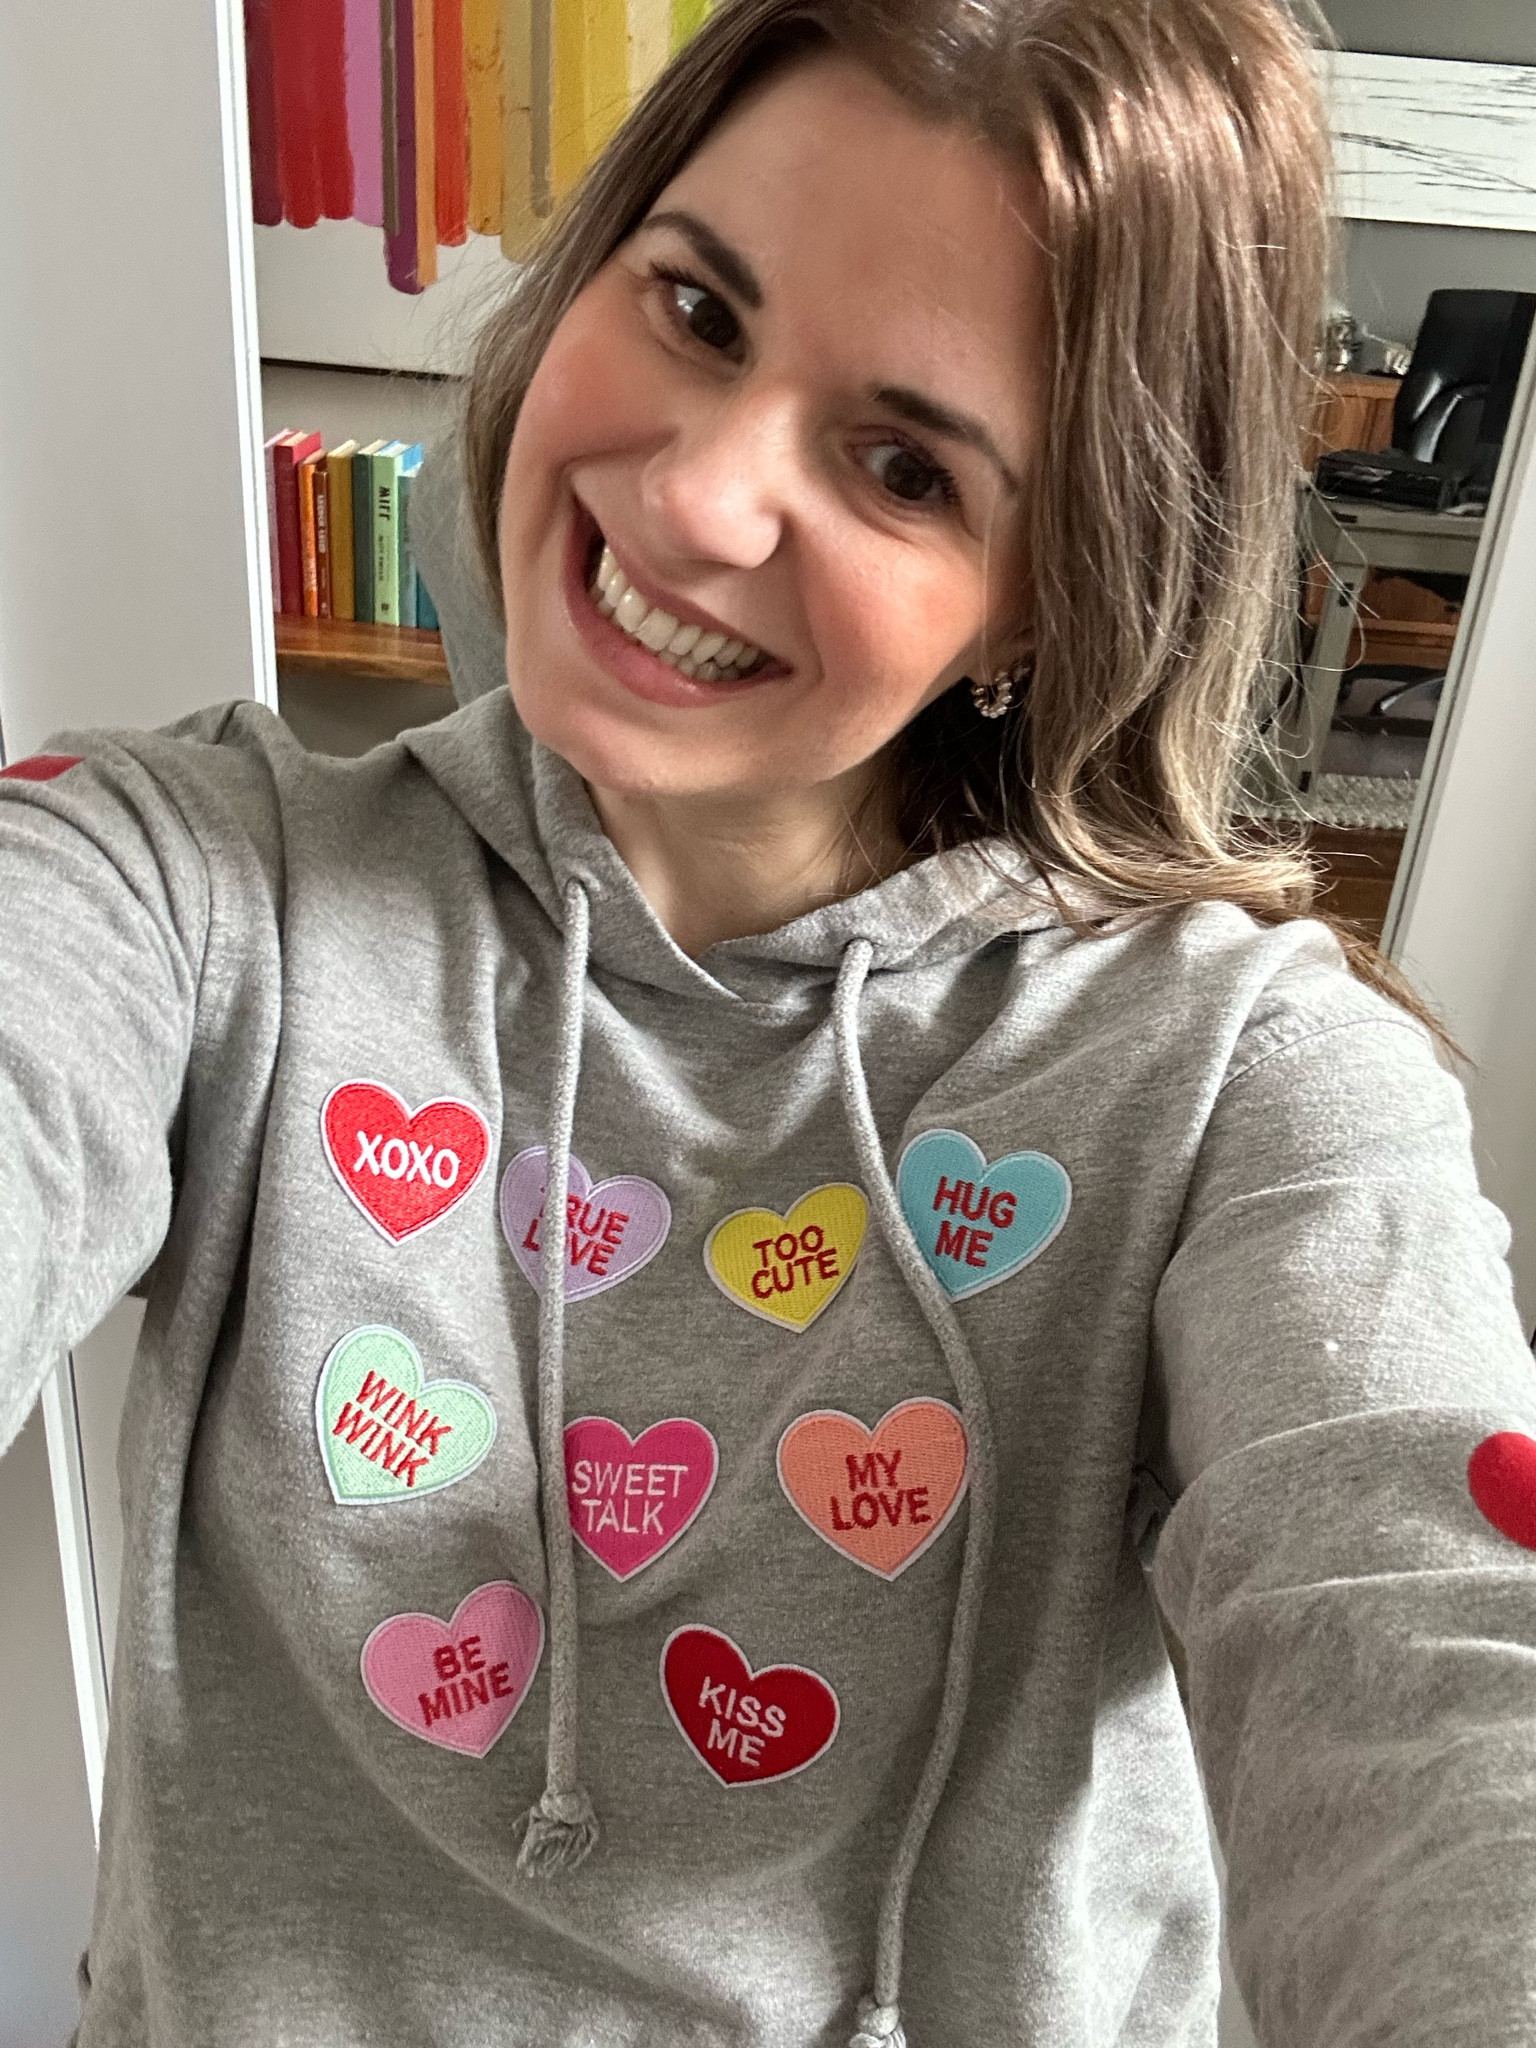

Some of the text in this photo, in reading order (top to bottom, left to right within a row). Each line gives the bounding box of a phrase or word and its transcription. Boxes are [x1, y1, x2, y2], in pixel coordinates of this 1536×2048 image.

[354, 1130, 461, 1189] XOXO
[538, 1186, 629, 1245] RUE
[933, 1175, 1018, 1229] HUG
[522, 1218, 615, 1276] LVE
[752, 1225, 825, 1269] TOO
[935, 1220, 994, 1268] ME
[751, 1247, 840, 1299] CUTE
[356, 1370, 452, 1455] WINK
[332, 1402, 430, 1488] WINK
[846, 1449, 902, 1491] MY
[572, 1459, 688, 1497] SWEET
[581, 1499, 664, 1535] TALK
[830, 1487, 932, 1531] LOVE
[433, 1635, 486, 1682] BE
[417, 1663, 514, 1727] MINE
[699, 1676, 787, 1738] KISS
[707, 1719, 767, 1767] ME
